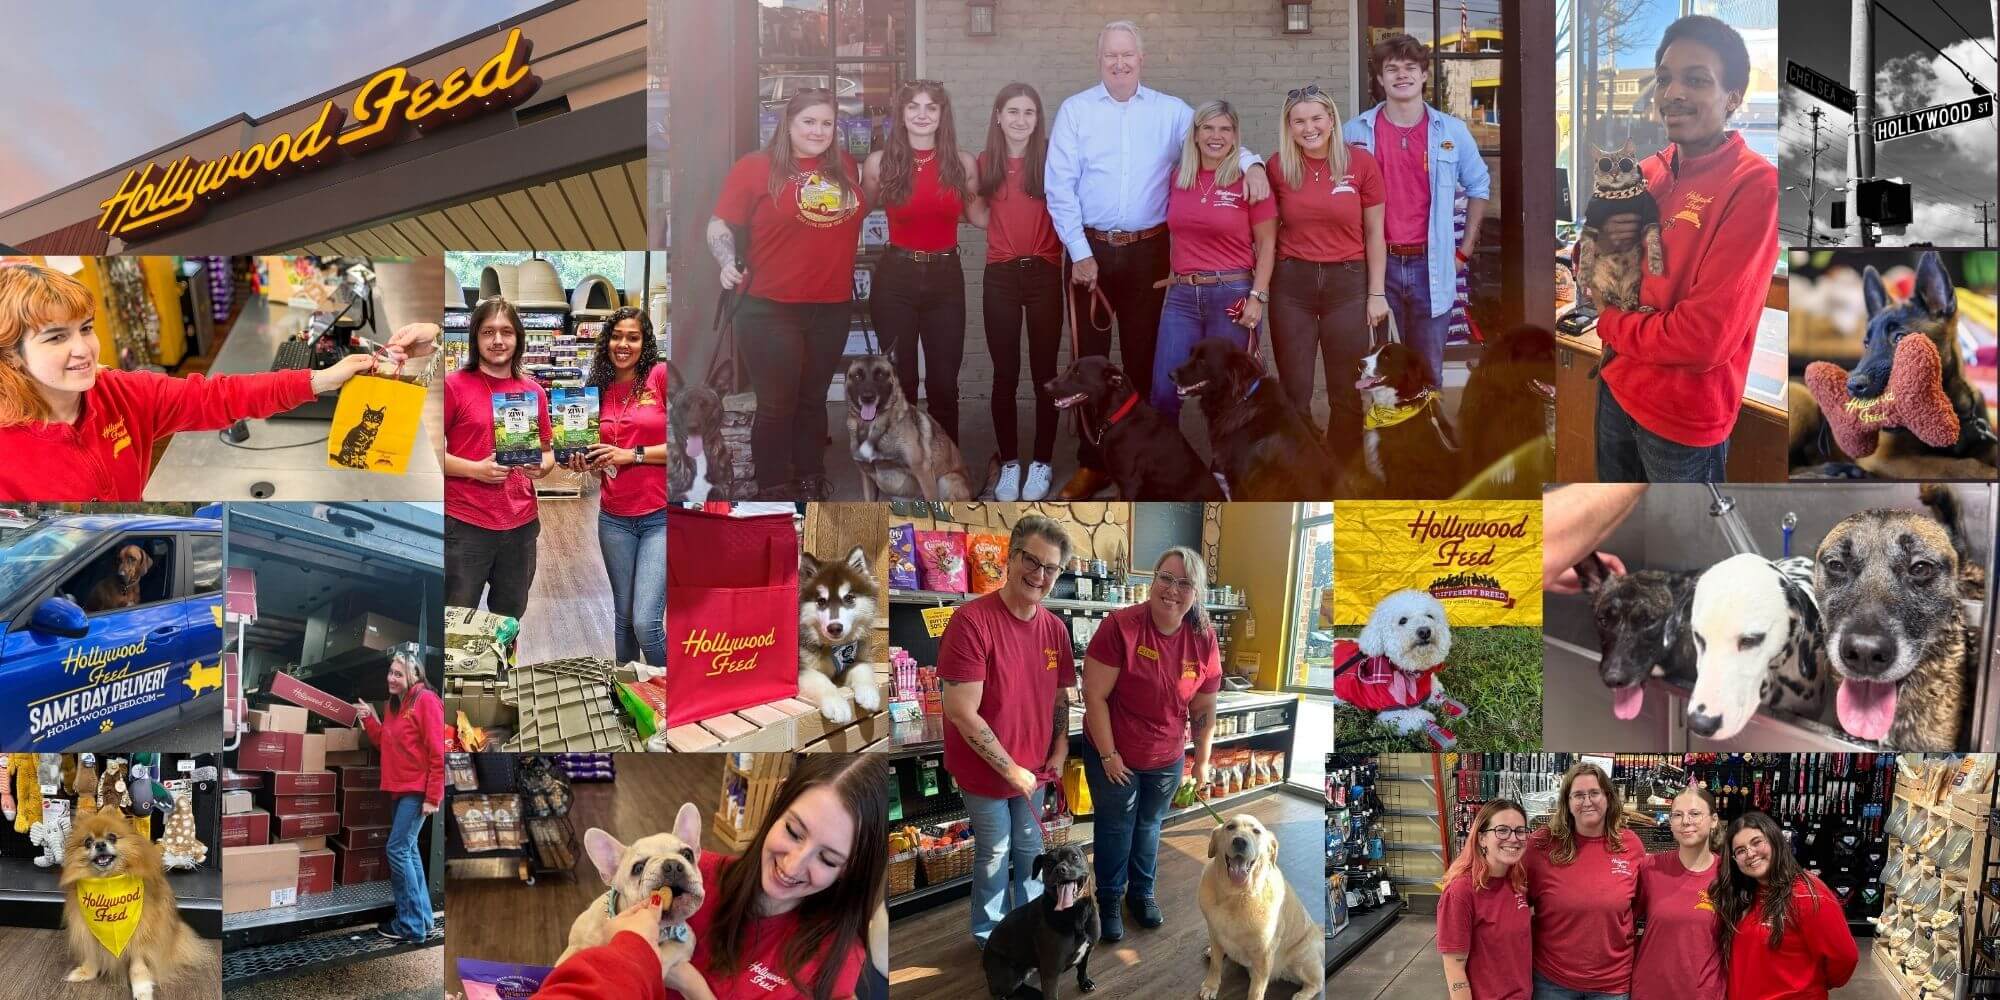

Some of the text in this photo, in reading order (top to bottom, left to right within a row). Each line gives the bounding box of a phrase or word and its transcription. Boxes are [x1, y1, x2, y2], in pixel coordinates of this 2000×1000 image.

[1788, 66, 1837, 102] CHELSEA
[98, 27, 528, 236] Hollywood Feed
[1877, 101, 1990, 140] HOLLYWOOD ST
[1408, 510, 1529, 544] Hollywood
[1433, 538, 1496, 567] Feed
[1435, 589, 1478, 598] DIFFERENT
[61, 634, 147, 676] Hollywood
[681, 627, 775, 657] Hollywood
[88, 661, 130, 687] Feed
[706, 652, 758, 676] Feed
[29, 666, 170, 734] SAME DAY DELIVERY
[46, 694, 157, 738] HOLLYWOODFEED.COM
[82, 887, 141, 910] Hollywood
[94, 906, 128, 922] Feed
[750, 975, 778, 991] Feed
